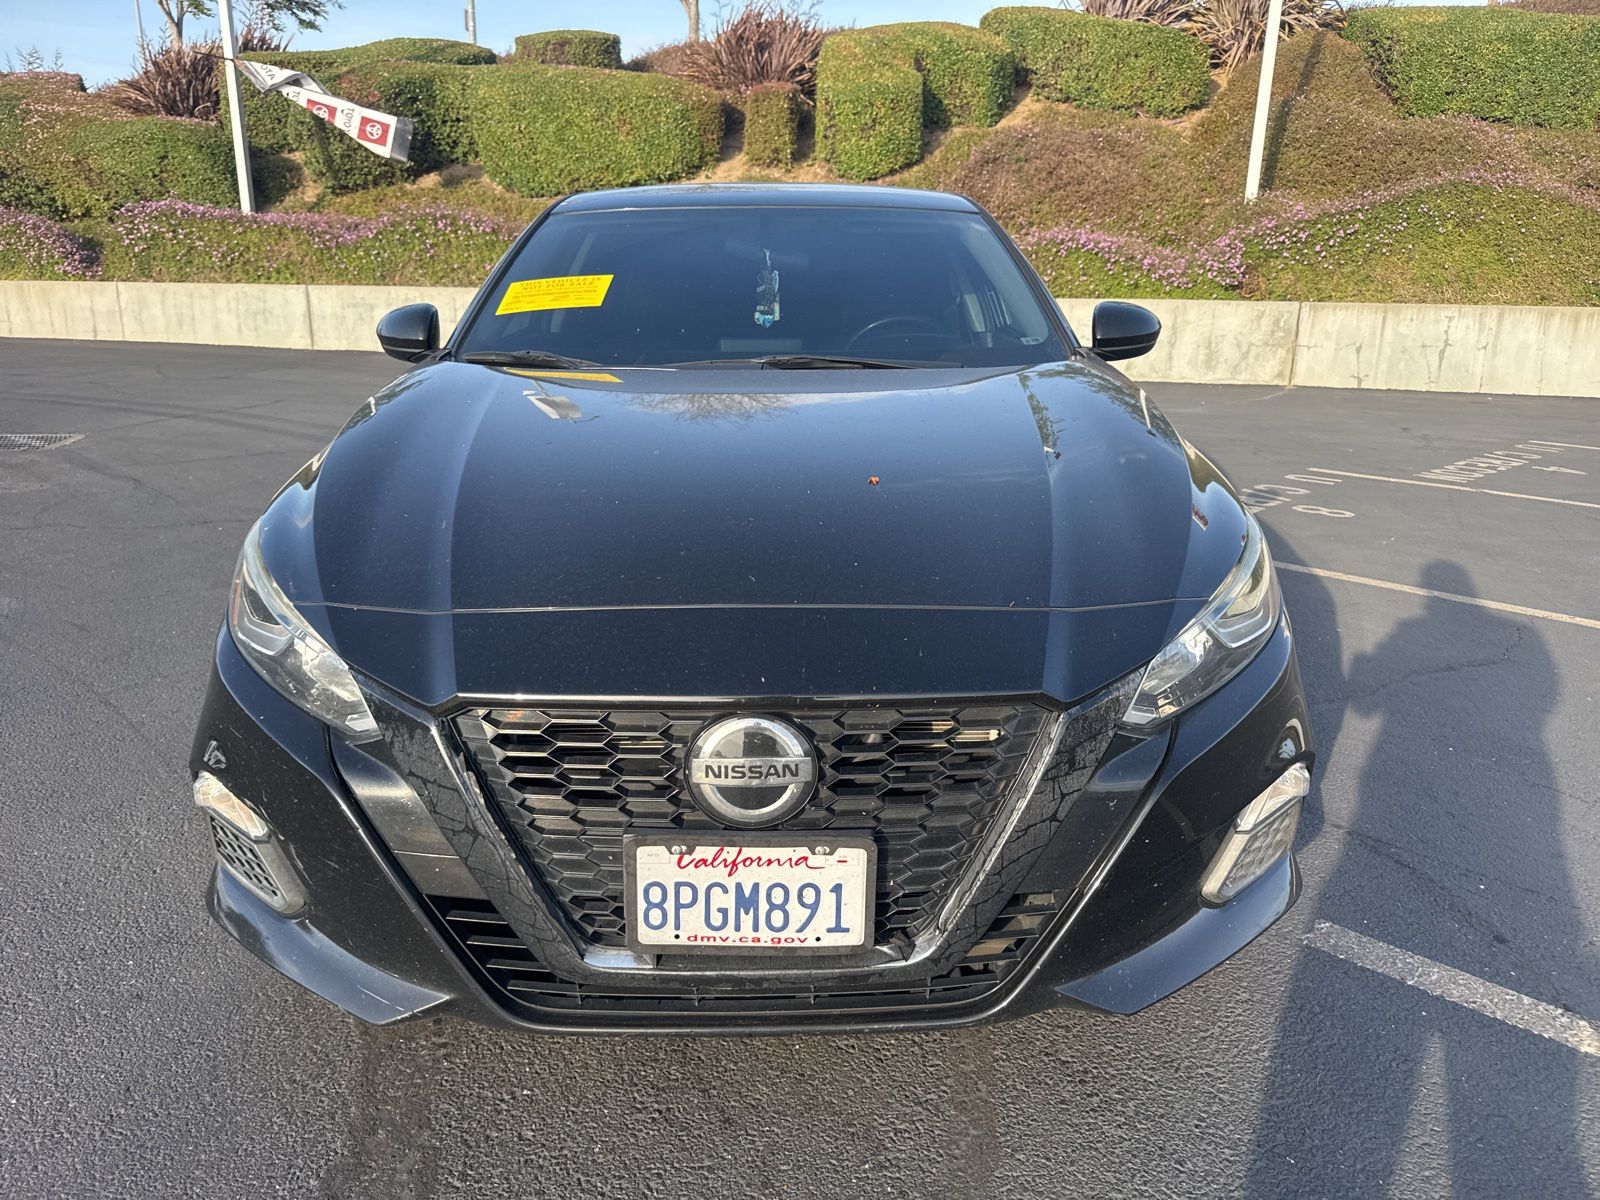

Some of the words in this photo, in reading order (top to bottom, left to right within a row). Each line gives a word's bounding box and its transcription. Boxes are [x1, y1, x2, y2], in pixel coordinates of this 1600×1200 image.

[1291, 504, 1356, 518] 8
[704, 763, 799, 780] NISSAN
[676, 846, 826, 877] California
[642, 880, 851, 934] 8PGM891
[686, 932, 809, 945] dmv.ca.gov
